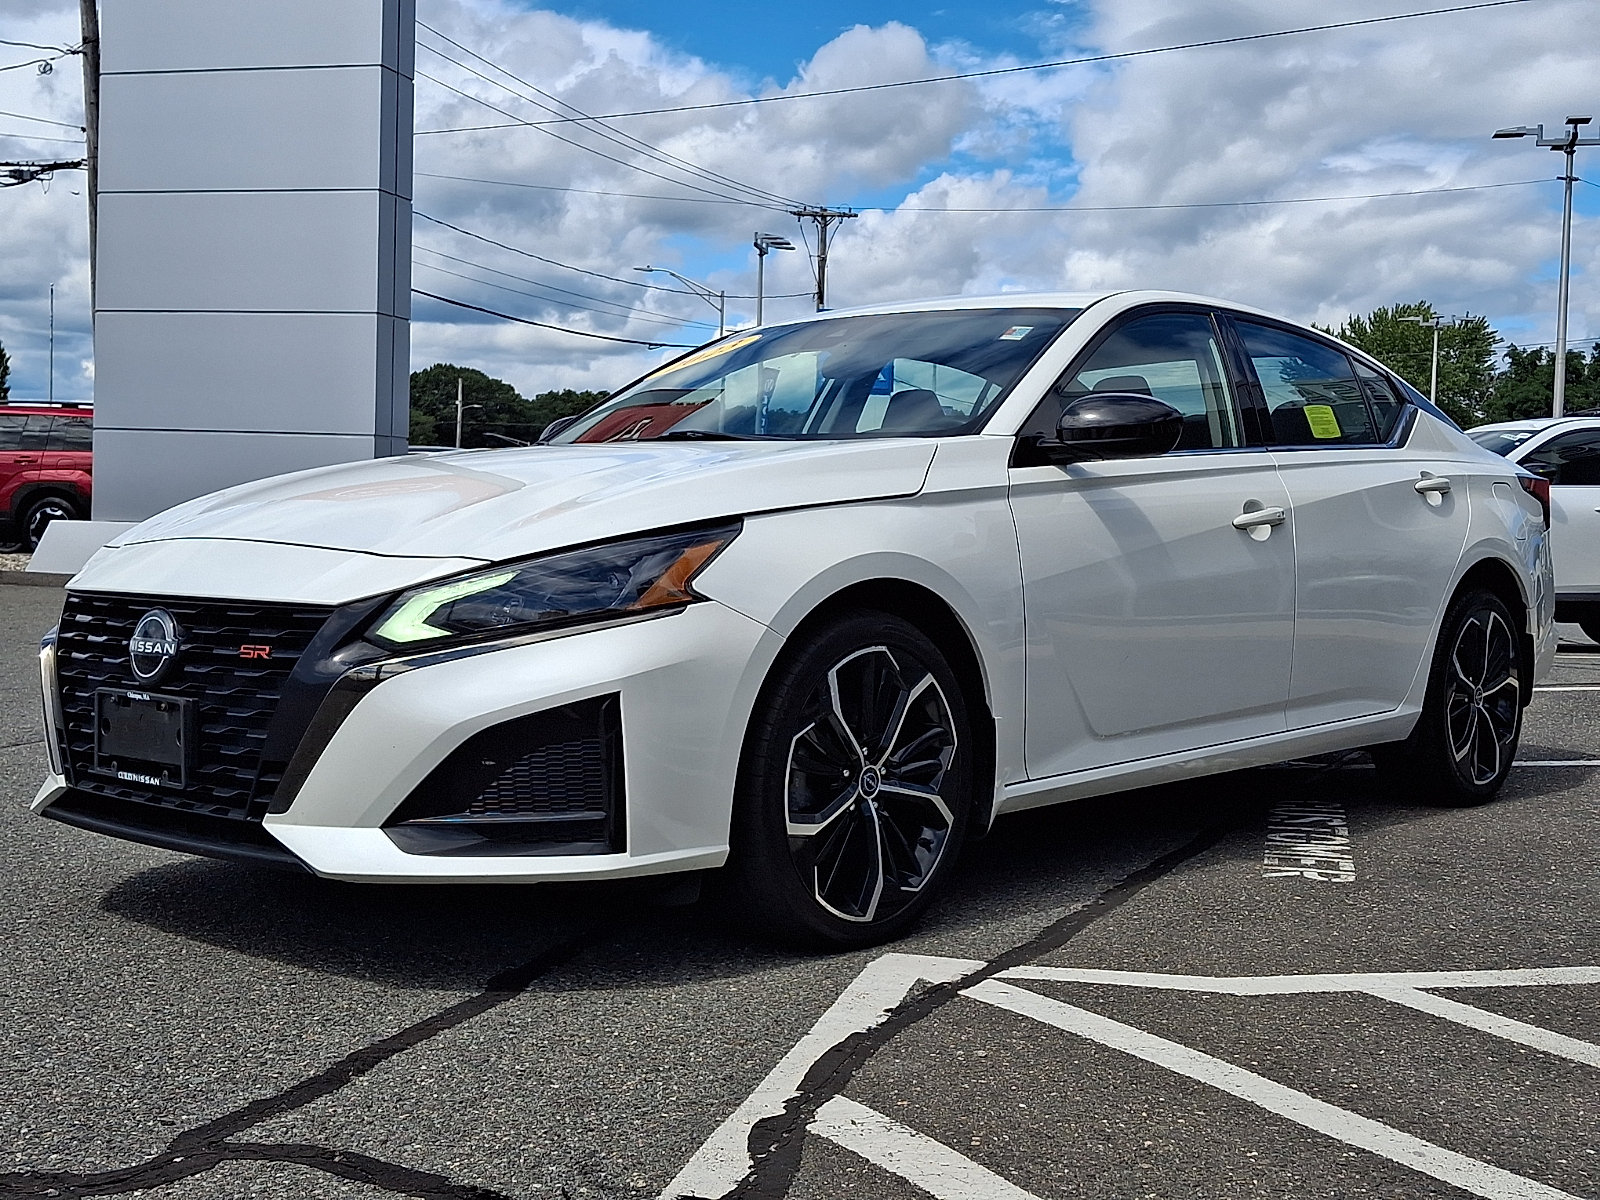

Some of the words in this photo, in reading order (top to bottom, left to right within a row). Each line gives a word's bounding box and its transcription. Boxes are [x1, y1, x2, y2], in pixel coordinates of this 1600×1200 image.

[130, 640, 175, 655] NISSAN
[239, 644, 271, 660] SR
[1262, 800, 1356, 882] CUSTOMER
